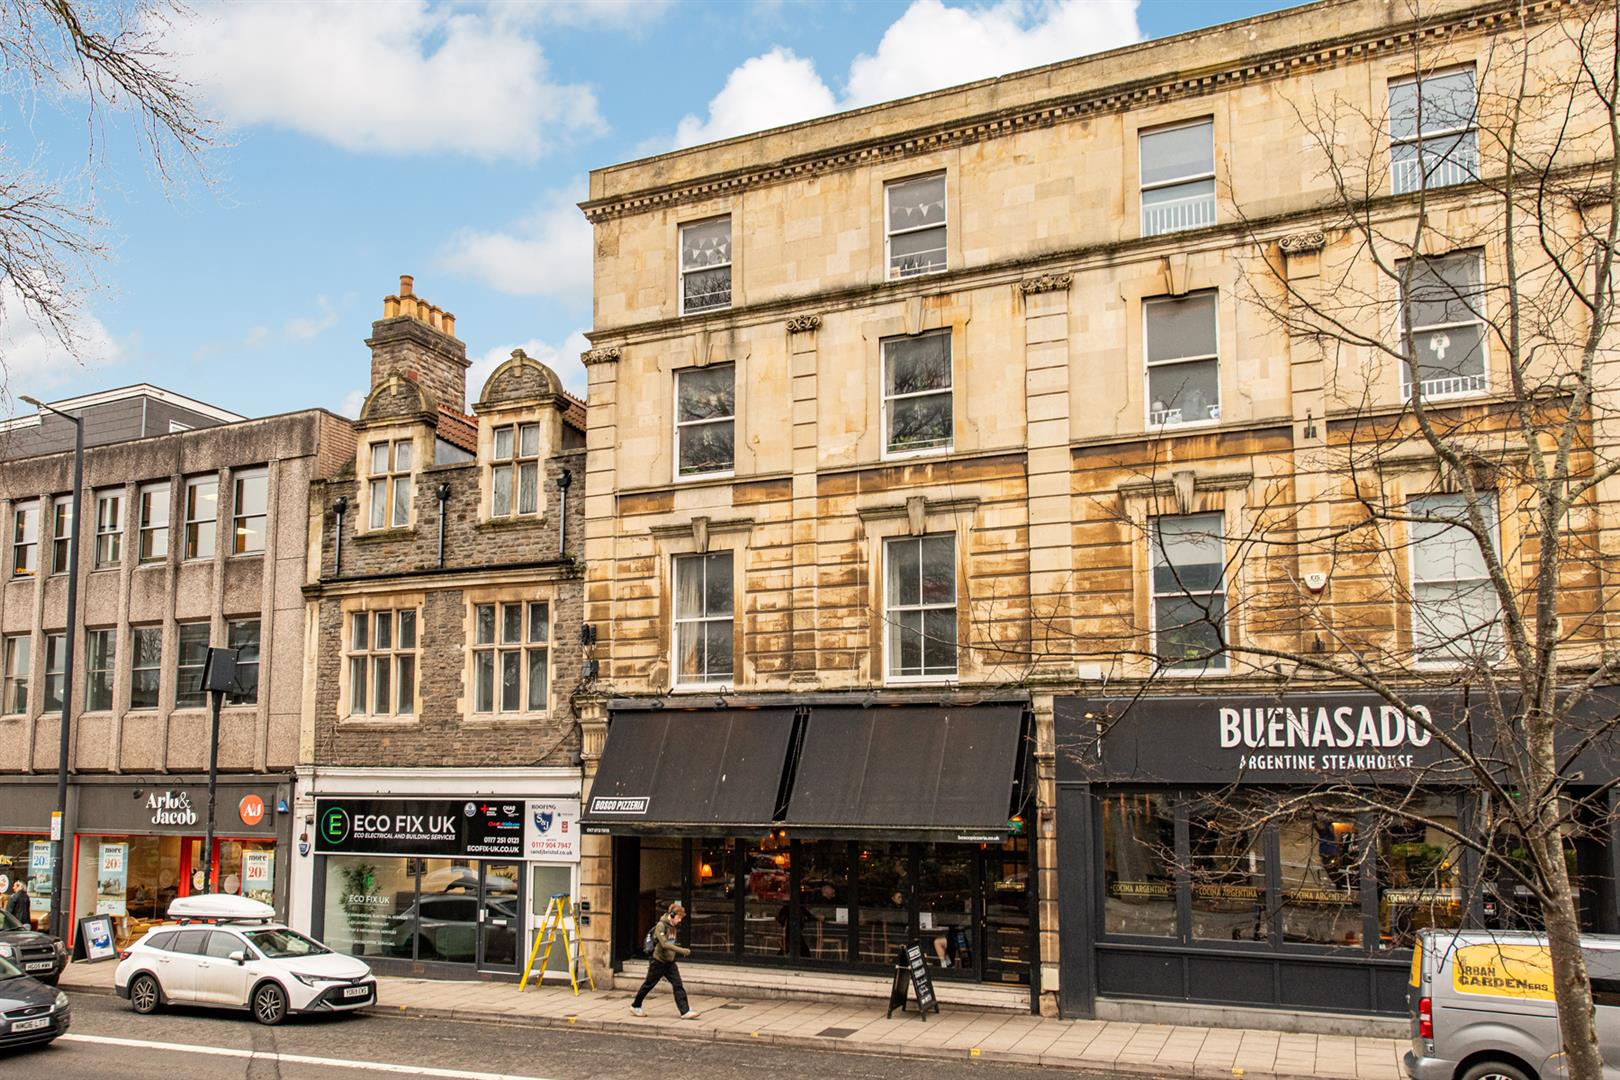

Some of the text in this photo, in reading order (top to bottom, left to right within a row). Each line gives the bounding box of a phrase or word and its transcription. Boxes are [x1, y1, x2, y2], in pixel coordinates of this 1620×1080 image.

[1219, 704, 1432, 748] BUENASADO
[1239, 755, 1315, 770] ARGENTINE
[594, 800, 645, 811] BOSCO PIZZERIA
[151, 808, 197, 825] Jacob
[353, 814, 456, 833] ECO FIX UK
[466, 845, 520, 853] ECOFIX-UK.CO.UK
[248, 854, 268, 862] more
[1112, 884, 1169, 894] COCINA ARGENTINA
[1198, 886, 1221, 896] COCINA
[349, 895, 390, 904] ECO FIX UK
[1458, 975, 1549, 992] GARDENERS
